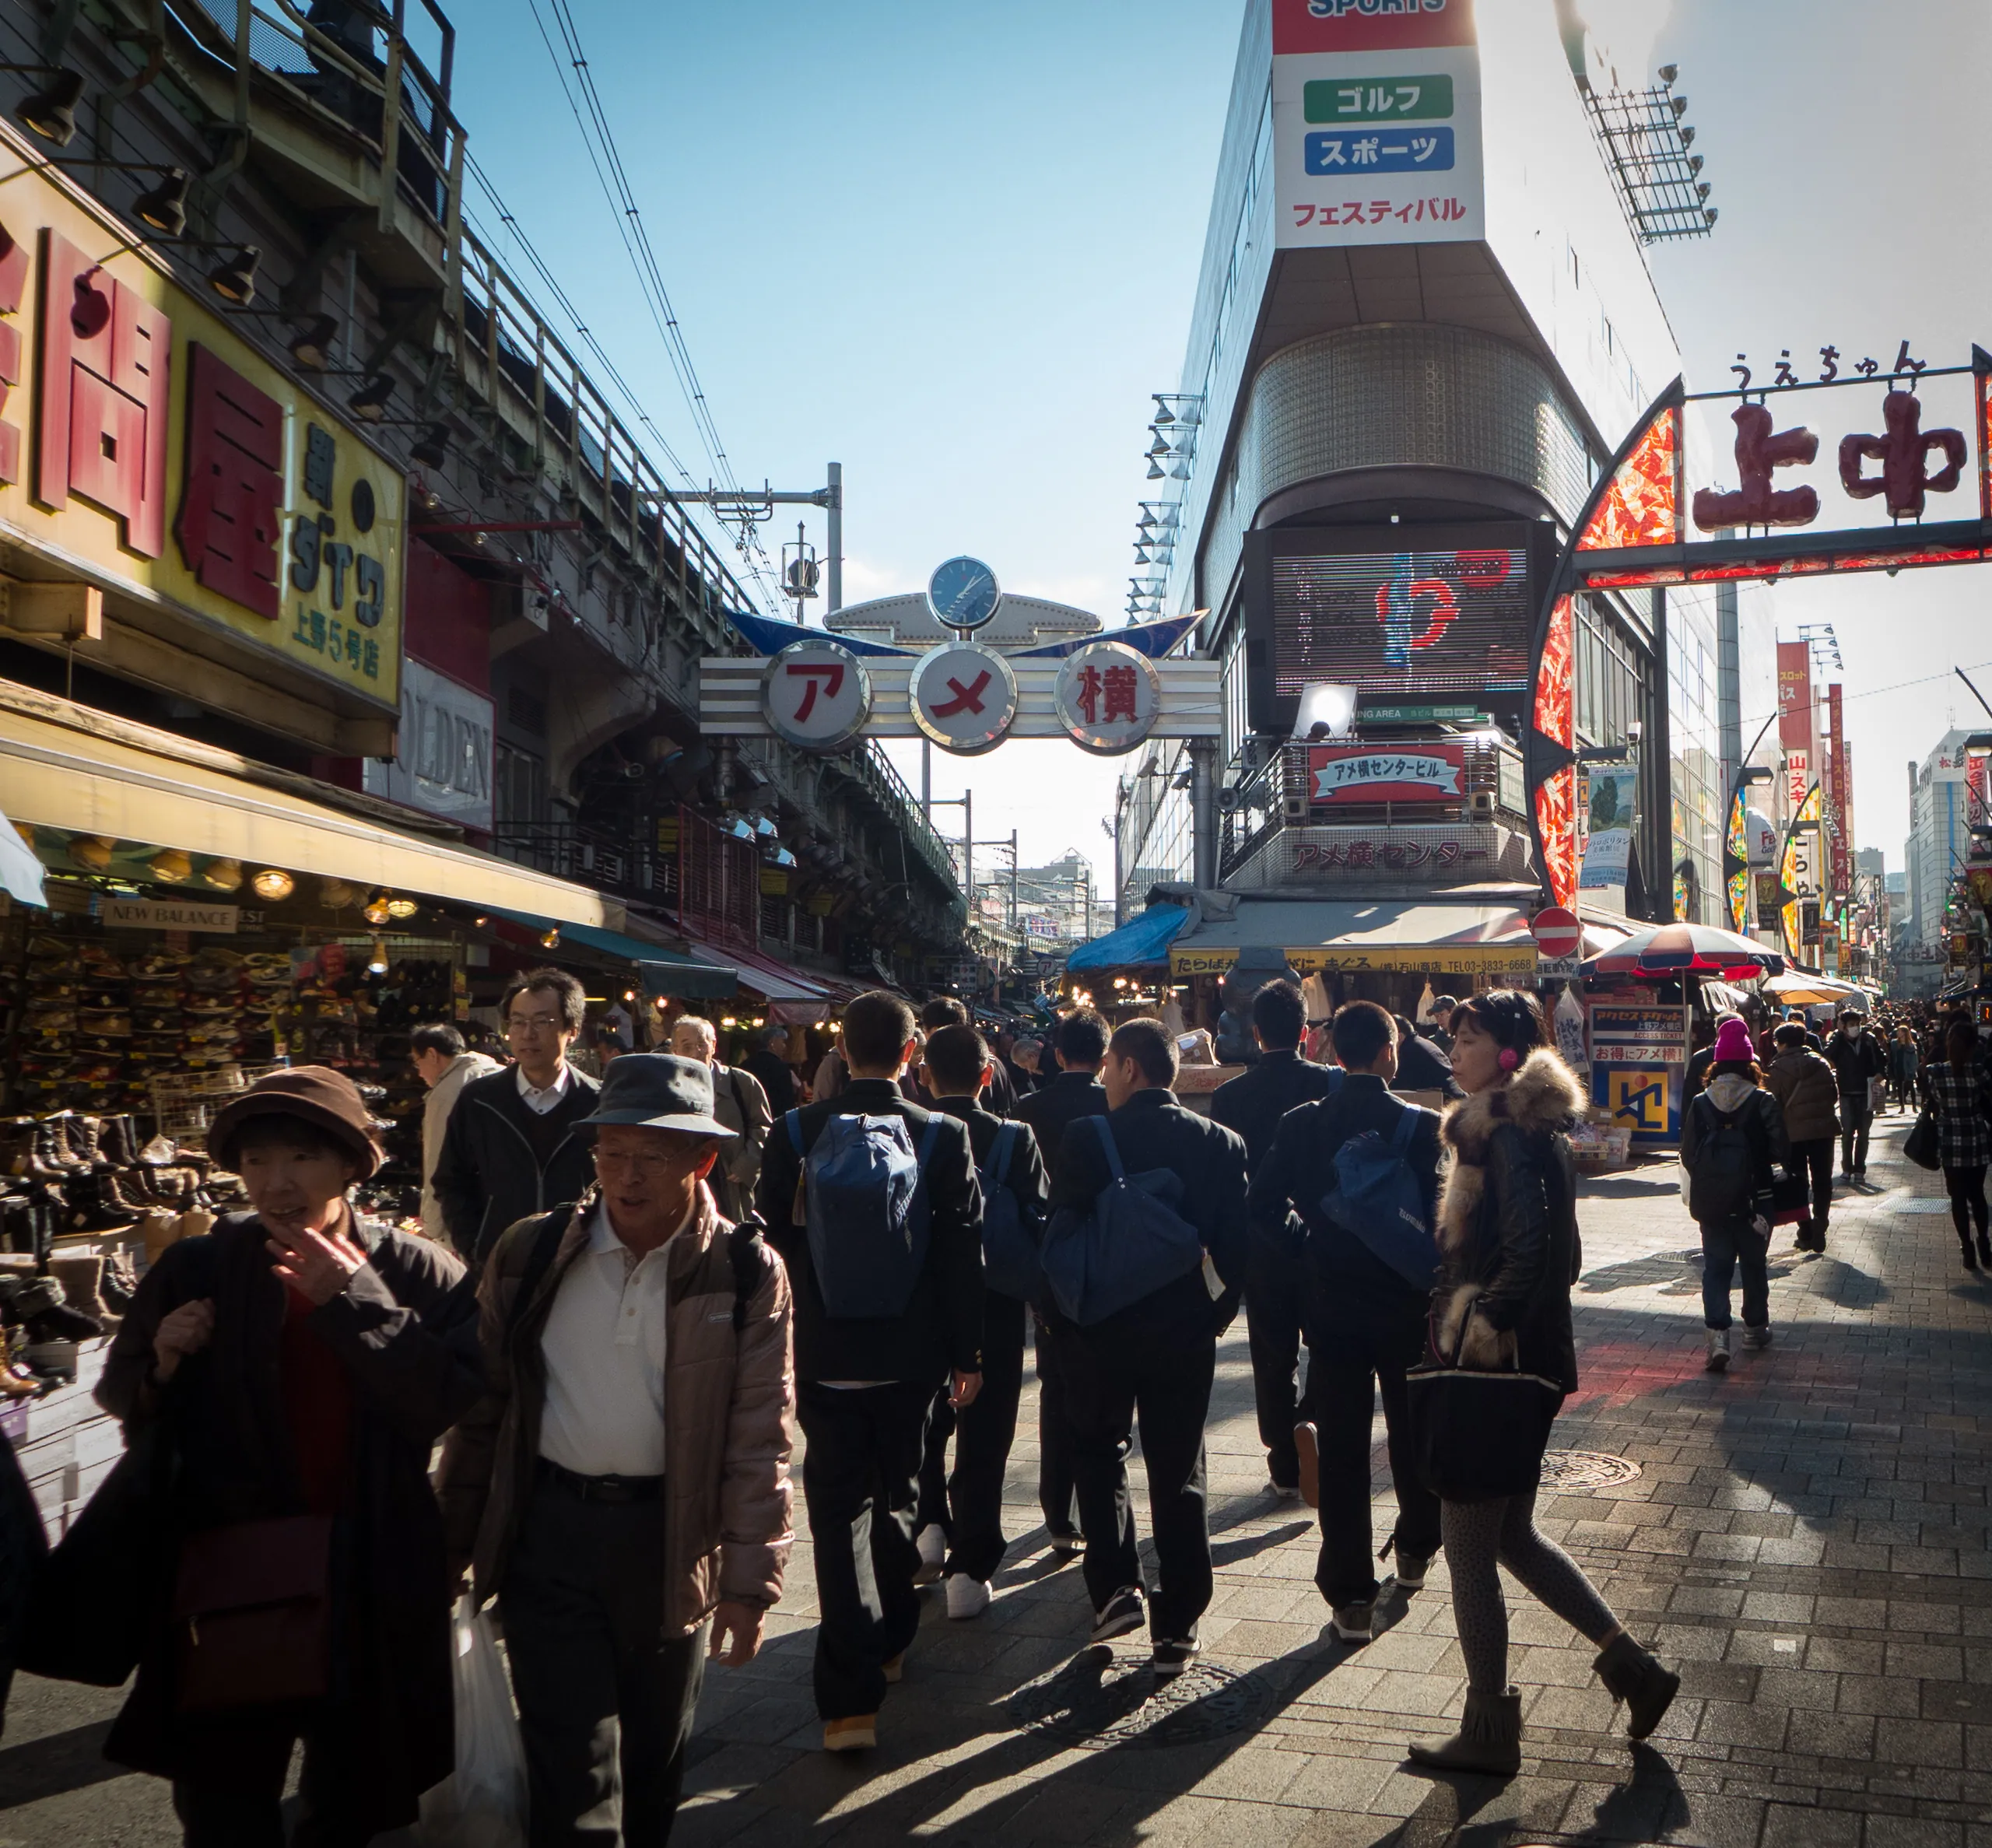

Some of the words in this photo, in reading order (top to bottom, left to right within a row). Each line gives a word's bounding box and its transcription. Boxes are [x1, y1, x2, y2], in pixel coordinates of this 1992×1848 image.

[1338, 86, 1421, 114] ゴルフ
[1320, 137, 1438, 167] スポーツ
[1293, 197, 1467, 227] フェスティバル
[1730, 340, 1927, 390] うえちゅん
[1692, 390, 1968, 533] 上中
[786, 663, 1139, 724] アメ横
[1375, 709, 1401, 719] AREA
[1334, 759, 1440, 781] アメ横センタービル
[1789, 755, 1806, 813] 山・スキ
[1292, 839, 1488, 871] アメ横センター
[113, 905, 151, 920] NEW
[156, 908, 230, 926] BALANCE
[1595, 1047, 1682, 1062] お得にアメ横!
